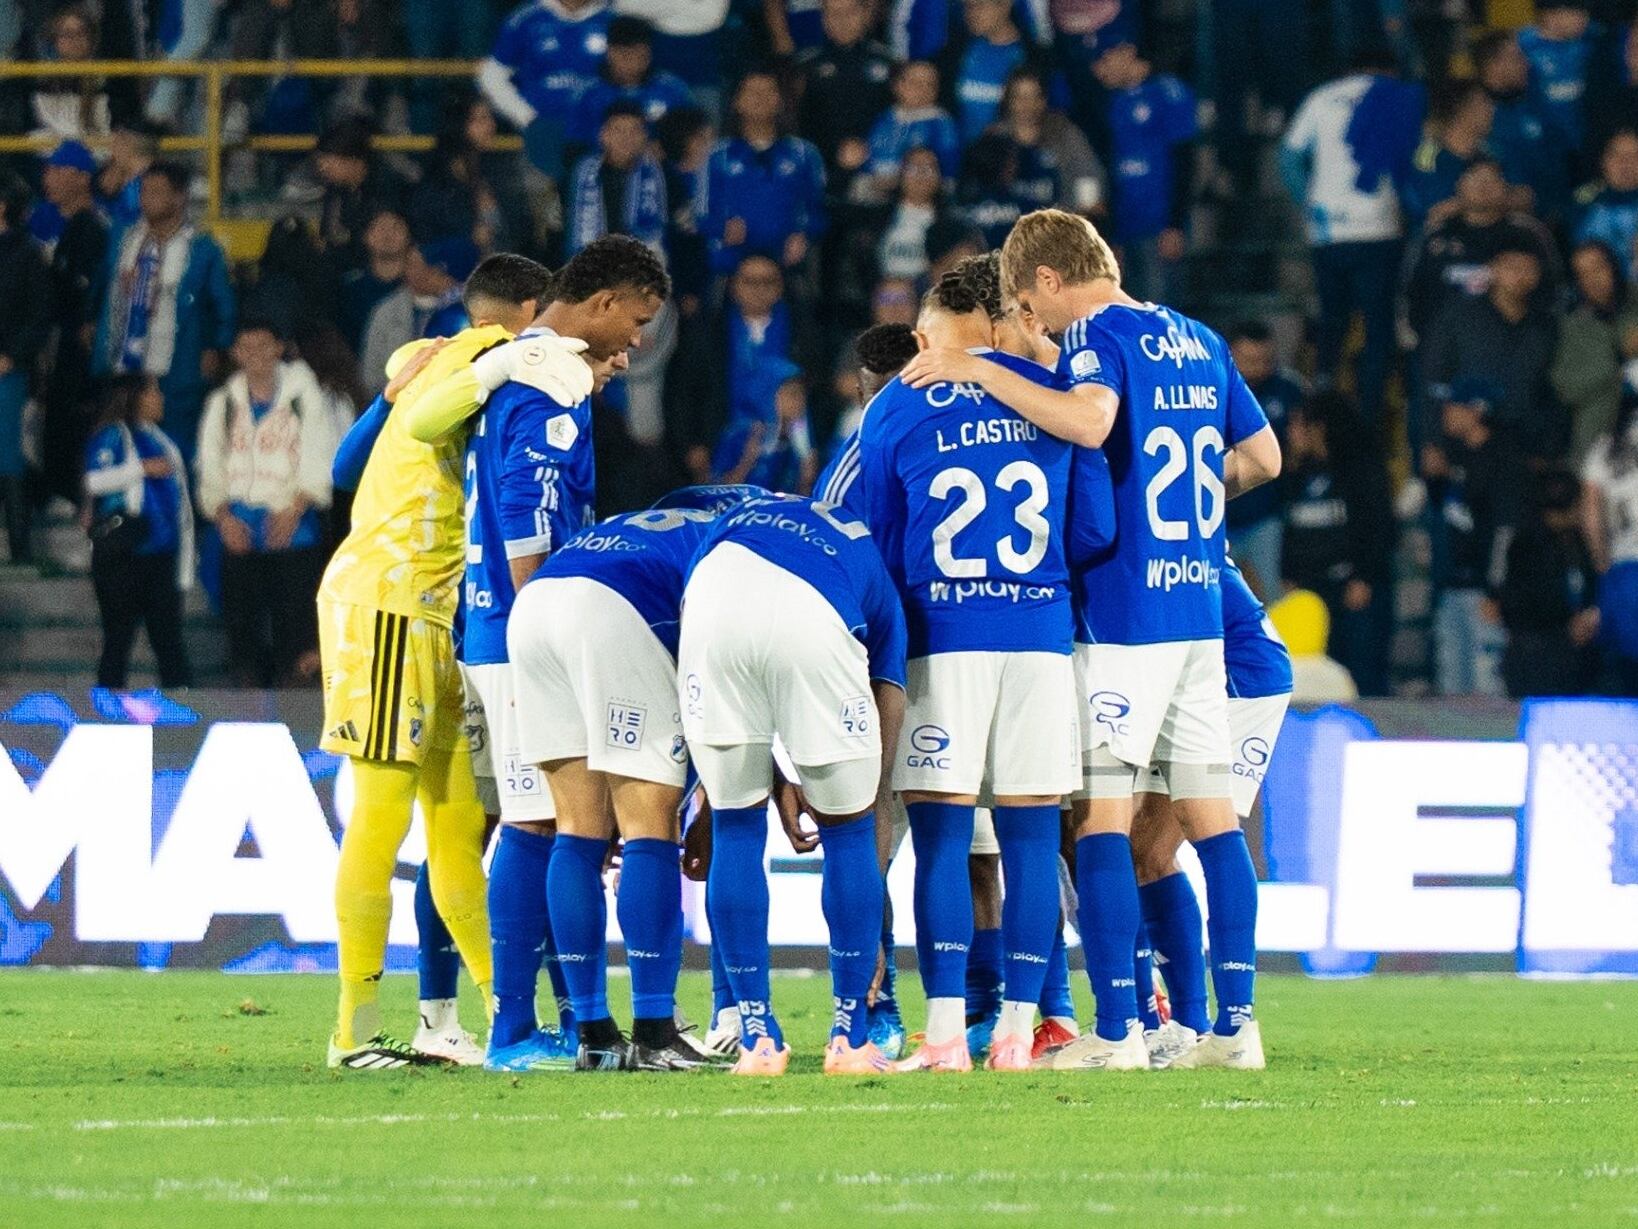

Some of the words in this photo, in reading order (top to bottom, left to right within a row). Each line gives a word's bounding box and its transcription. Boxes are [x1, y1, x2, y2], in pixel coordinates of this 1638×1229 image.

[960, 418, 1038, 446] CASTRO
[1143, 425, 1225, 541] 26
[928, 461, 1050, 578] 23
[907, 754, 952, 771] GAC
